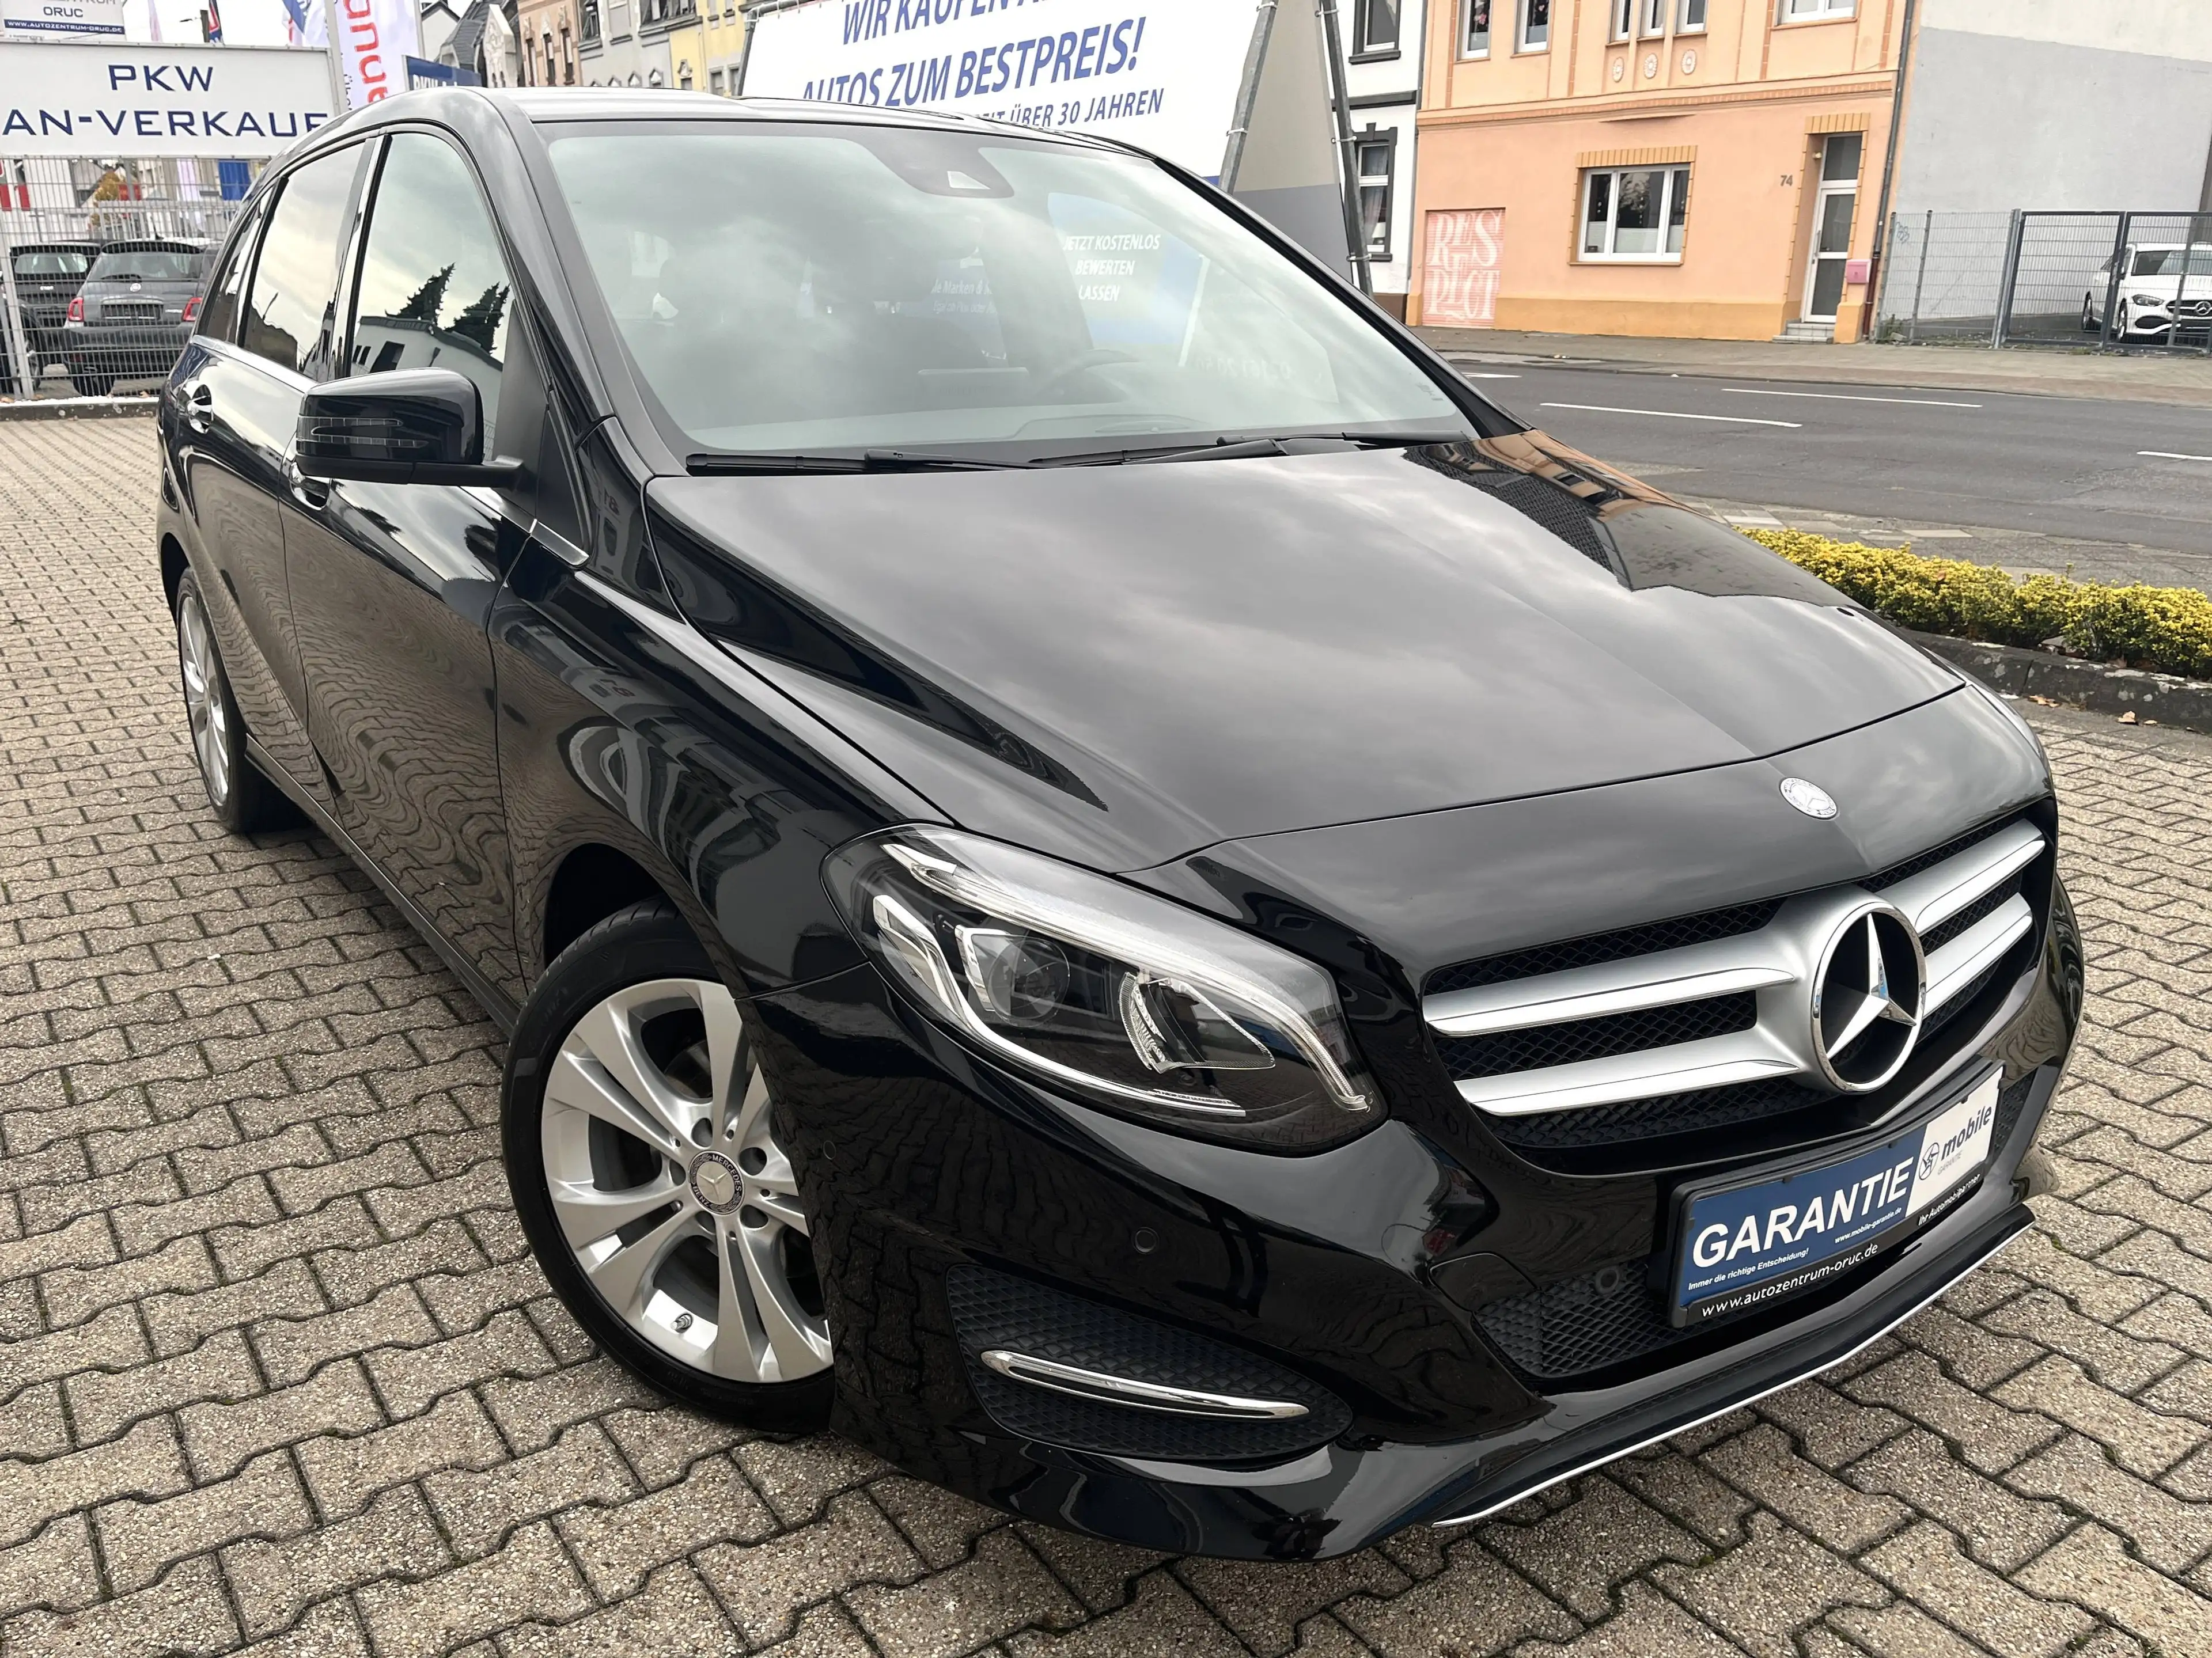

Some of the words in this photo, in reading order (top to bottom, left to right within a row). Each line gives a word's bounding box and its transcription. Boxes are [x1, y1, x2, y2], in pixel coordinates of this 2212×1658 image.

[43, 6, 84, 18] ORUC
[843, 0, 889, 44] WIR
[108, 65, 213, 92] PKW
[885, 55, 952, 107] ZUM
[955, 16, 1146, 98] BESTPREIS!
[2, 109, 328, 137] AN-VERKAUF
[1058, 101, 1080, 126] 30
[1084, 88, 1164, 122] JAHREN
[1780, 174, 1793, 186] 74
[1063, 236, 1095, 251] JETZT
[1094, 234, 1161, 251] KOSTENLOS
[942, 280, 975, 294] Marken
[1075, 260, 1135, 276] BEWERTEN
[1078, 285, 1120, 301] LASSEN
[1941, 1106, 1992, 1162] mobile
[712, 1154, 743, 1192] MERCEDES
[692, 1186, 712, 1207] BENZ
[1692, 1156, 1914, 1268] GARANTIE
[1918, 1214, 1929, 1227] Ihr
[1928, 1174, 1981, 1219] Automobilpartner
[1835, 1206, 1902, 1244] www.mobile-garantie.de
[1688, 1277, 1713, 1291] Immer
[1714, 1273, 1726, 1283] die
[1727, 1265, 1756, 1279] richtige
[1757, 1247, 1809, 1270] Entscheidung!
[1702, 1243, 1878, 1317] www.autozentrum-oruc.de
